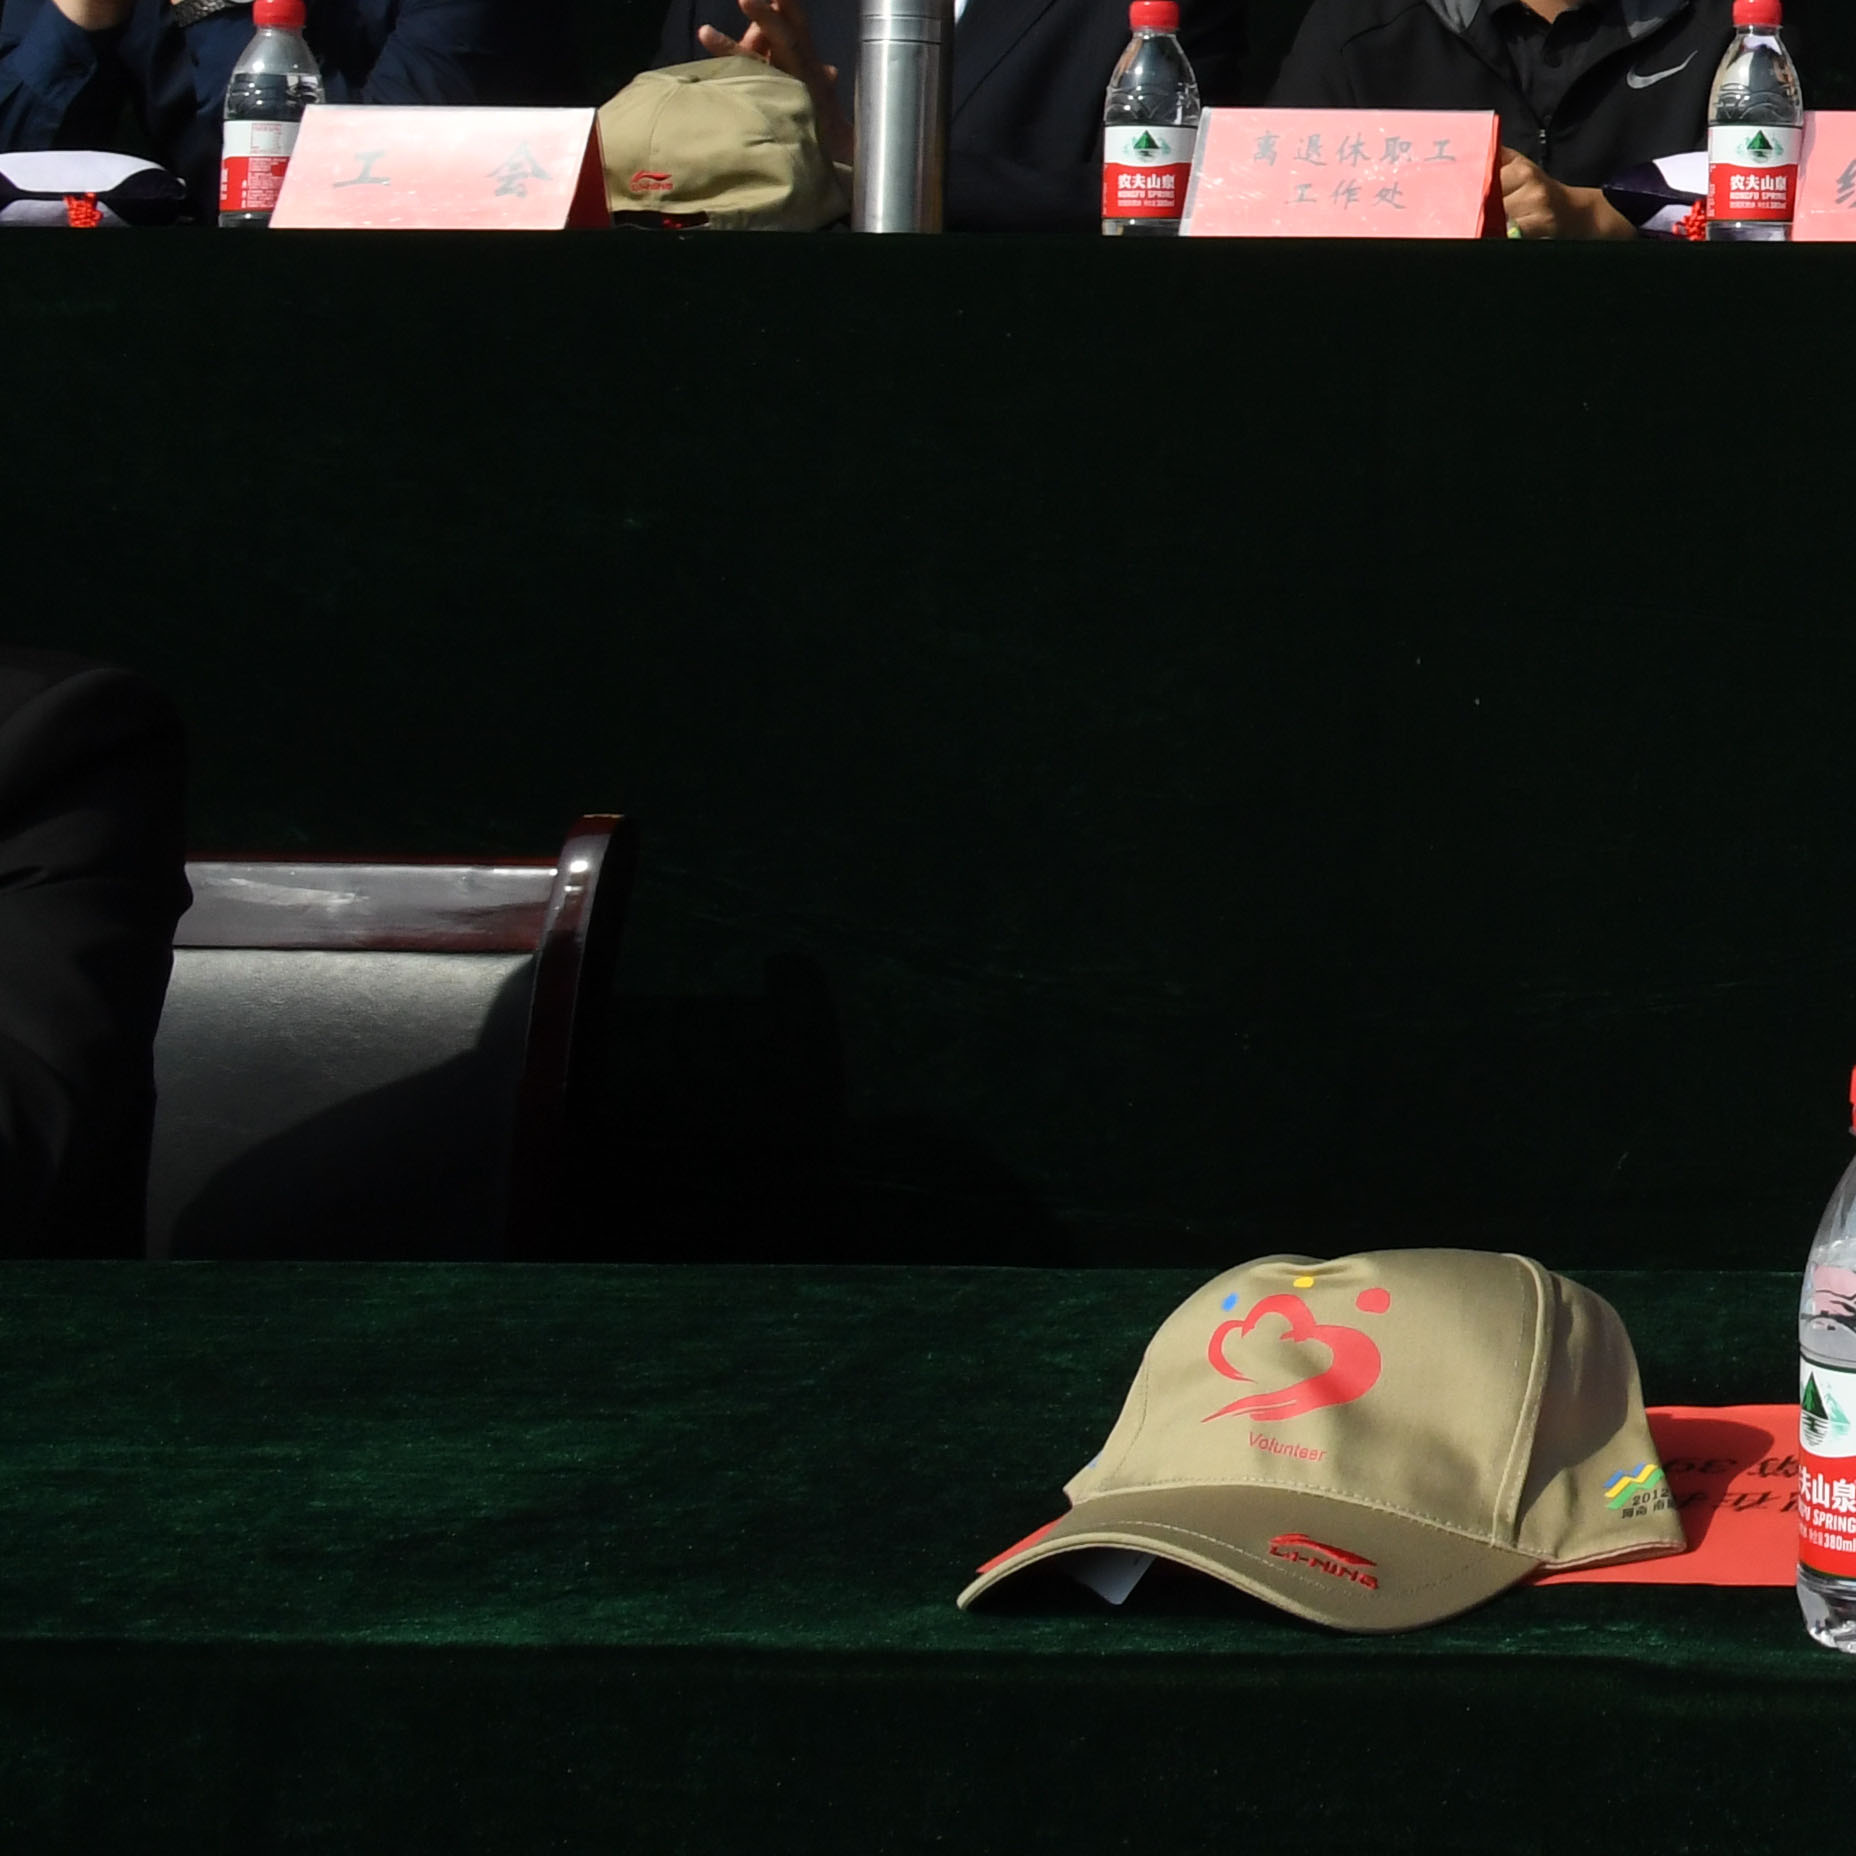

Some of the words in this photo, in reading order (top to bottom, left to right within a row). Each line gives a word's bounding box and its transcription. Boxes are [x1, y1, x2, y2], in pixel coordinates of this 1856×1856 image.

[1253, 130, 1457, 167] 离退休职工
[333, 141, 553, 199] 工会
[1285, 181, 1407, 211] 工作处
[1249, 1432, 1328, 1462] Volunteer
[1633, 1489, 1670, 1507] 2012
